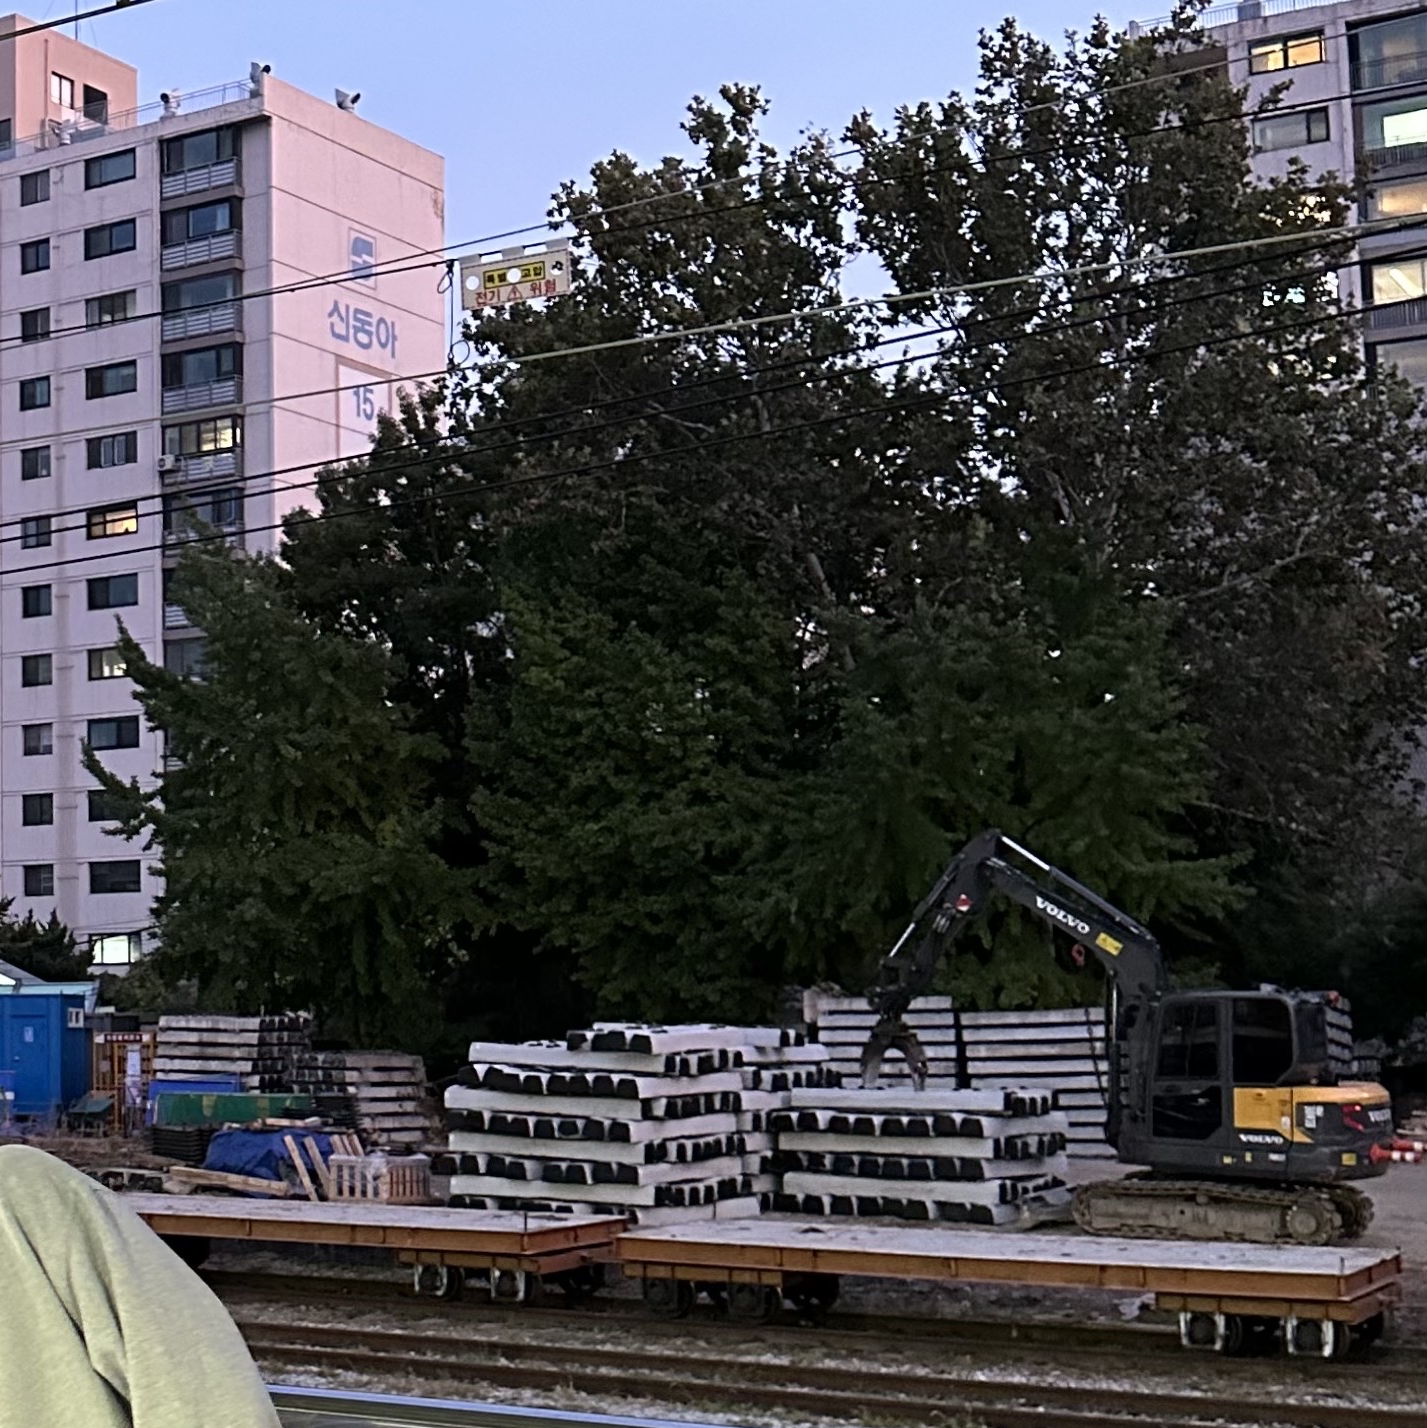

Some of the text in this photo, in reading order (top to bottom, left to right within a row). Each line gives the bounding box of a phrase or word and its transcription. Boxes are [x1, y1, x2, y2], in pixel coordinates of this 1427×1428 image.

[476, 289, 501, 306] 전기
[327, 299, 398, 359] 신동아
[353, 386, 374, 421] 15
[1036, 895, 1090, 934] VOLVO
[1238, 1133, 1284, 1145] VOLVO
